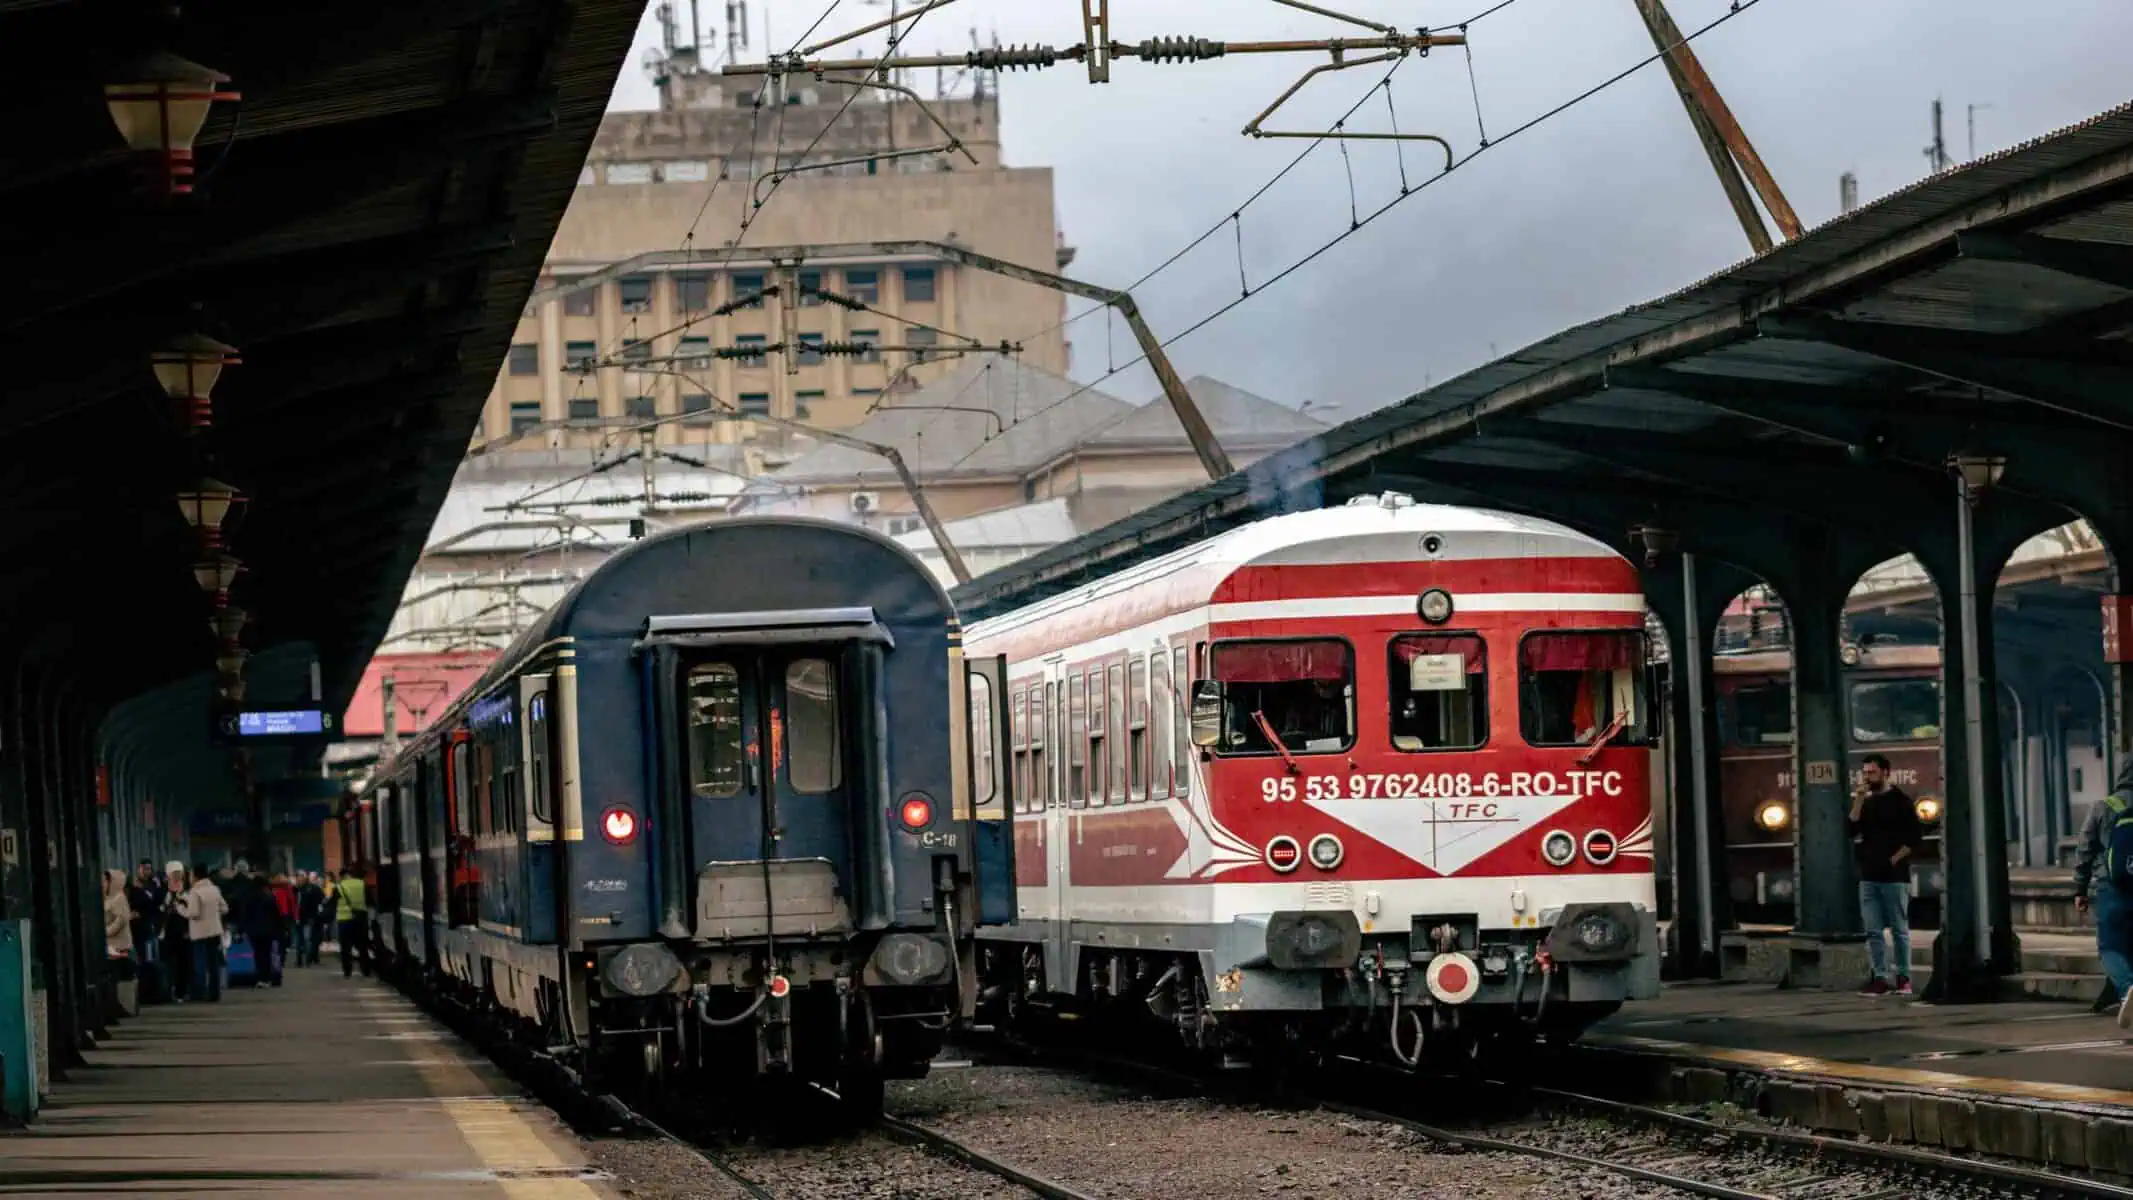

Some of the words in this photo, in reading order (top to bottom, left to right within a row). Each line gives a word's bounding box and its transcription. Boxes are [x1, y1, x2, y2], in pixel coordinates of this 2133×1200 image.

[1262, 777, 1297, 802] 95
[1306, 775, 1340, 800] 53
[1349, 770, 1623, 799] 9762408-6-RO-TFC
[1449, 803, 1499, 818] TFC
[923, 831, 957, 848] C-18
